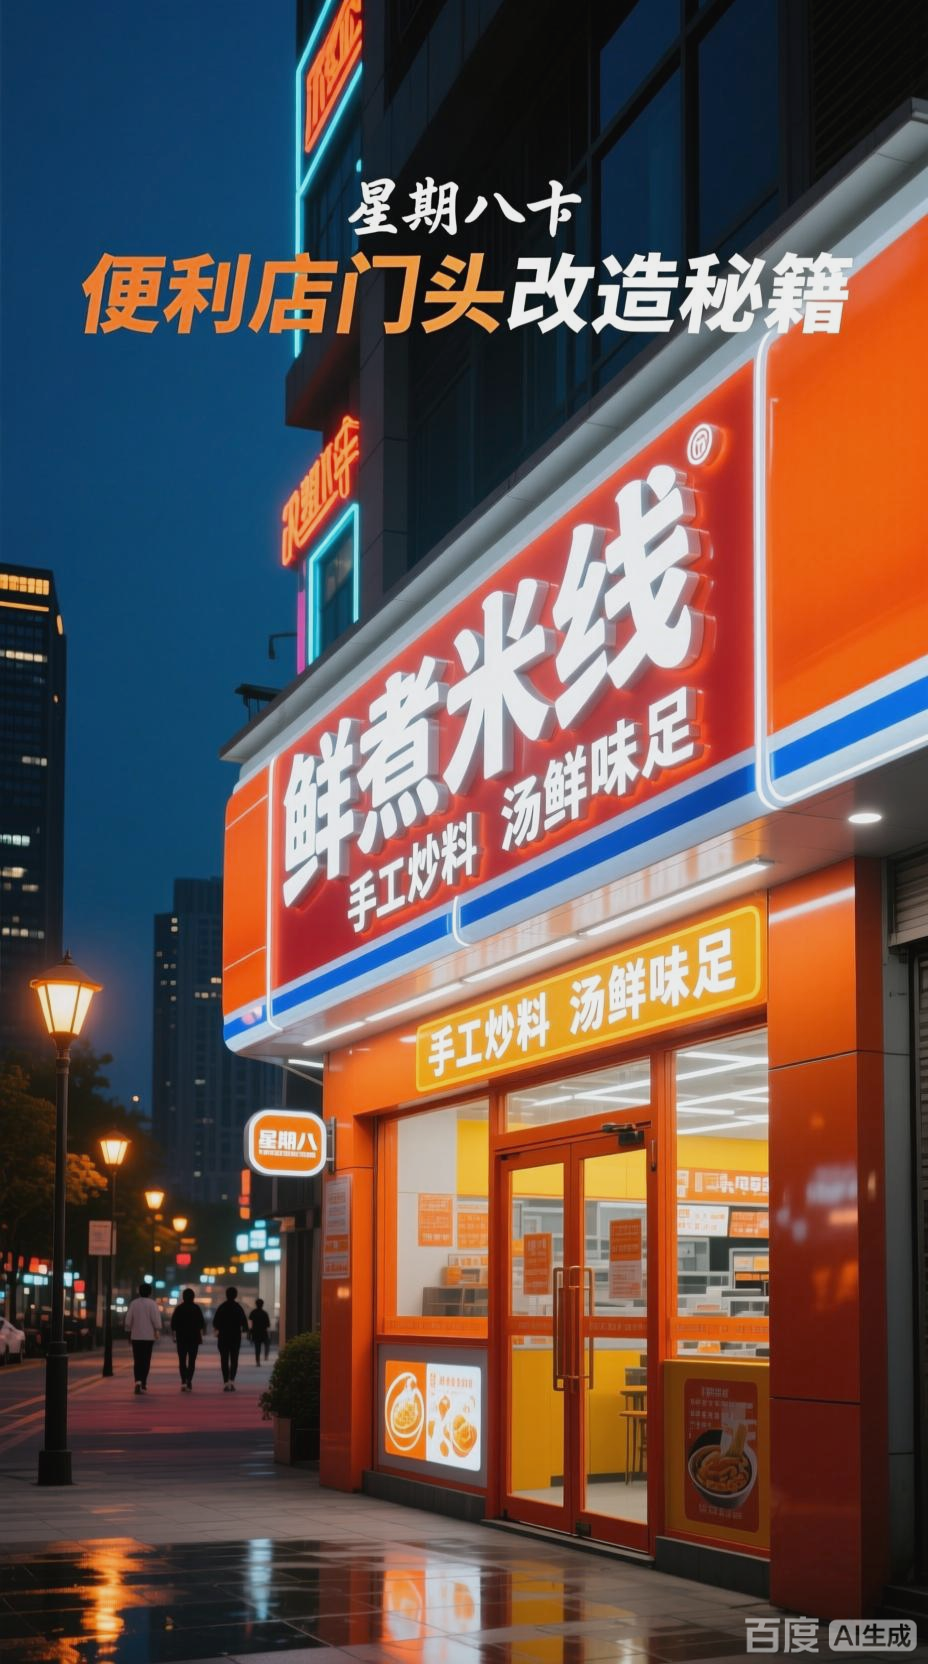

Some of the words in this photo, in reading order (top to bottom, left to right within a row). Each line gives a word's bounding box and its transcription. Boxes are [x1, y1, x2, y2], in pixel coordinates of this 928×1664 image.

[283, 464, 694, 908] 鲜煮米线
[347, 811, 478, 934] 手工炒料
[500, 686, 696, 852] 汤鲜味足
[428, 991, 550, 1078] 手工炒料
[569, 928, 737, 1036] 汤鲜味足
[258, 1129, 318, 1152] 星期八
